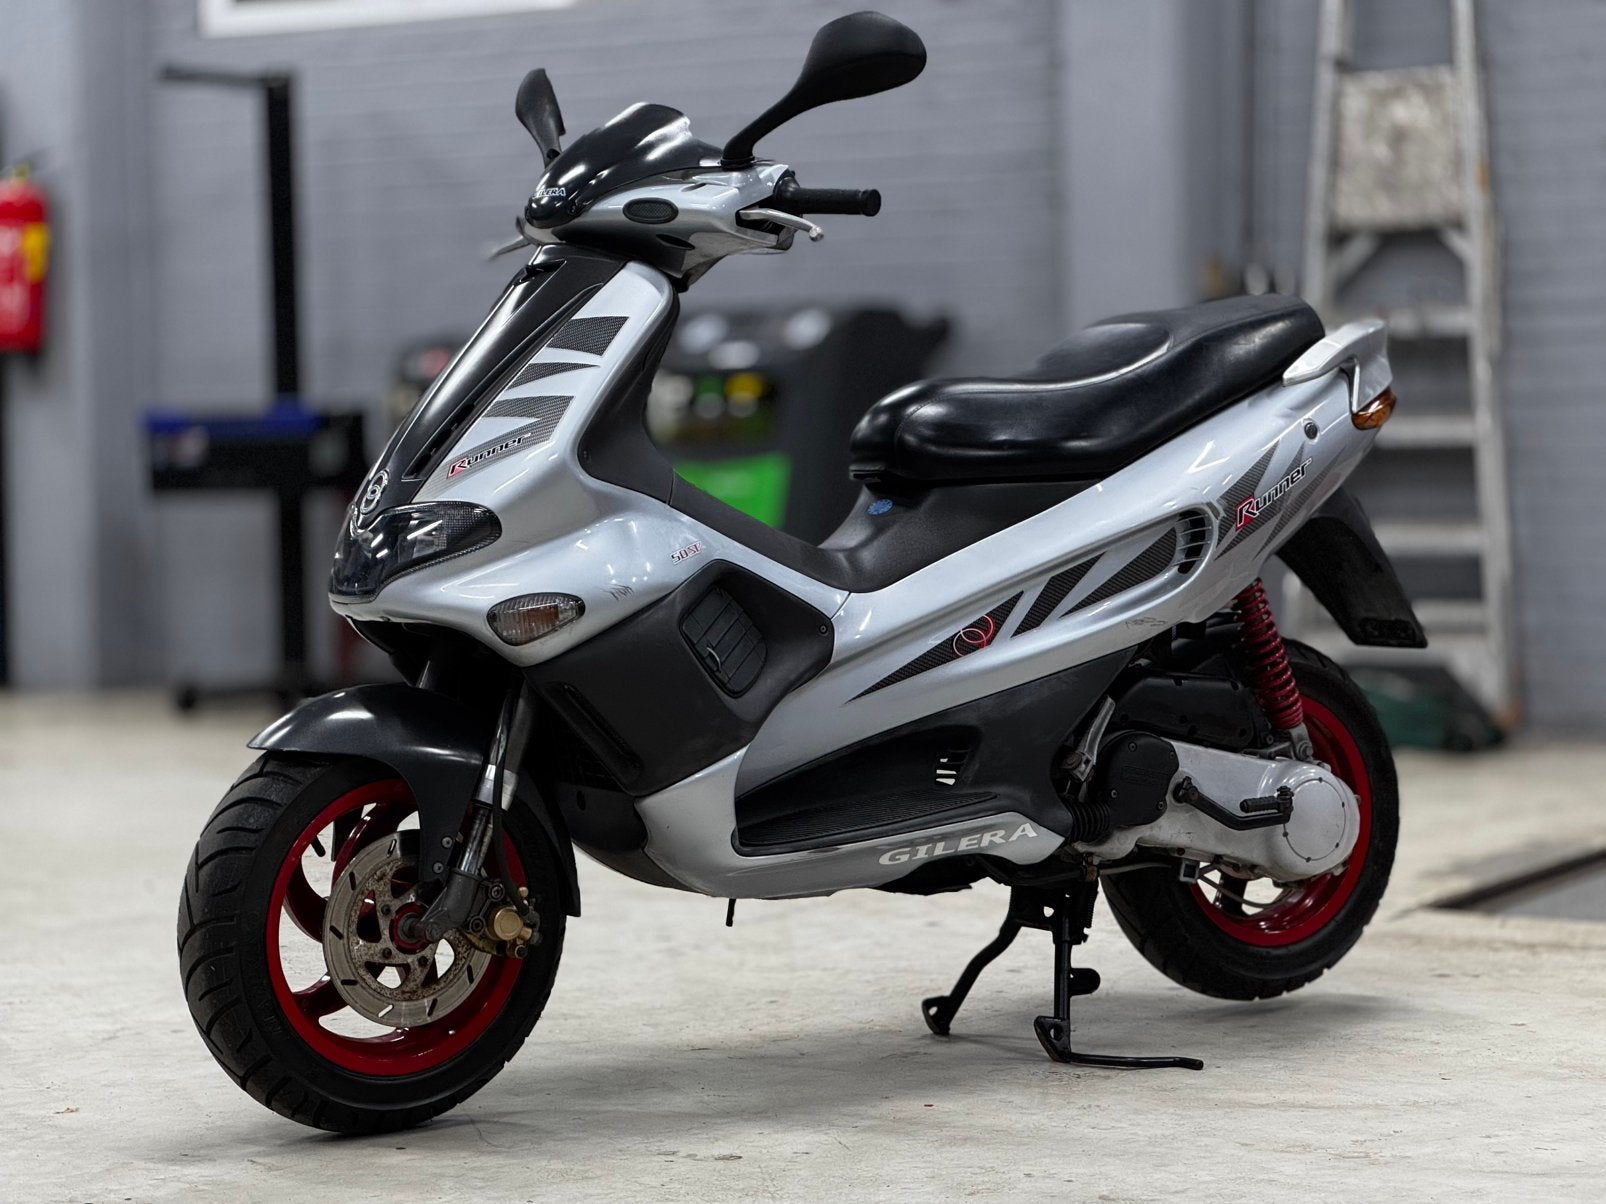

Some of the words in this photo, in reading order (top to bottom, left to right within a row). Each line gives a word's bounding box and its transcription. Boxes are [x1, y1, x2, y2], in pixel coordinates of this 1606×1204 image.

[447, 432, 531, 478] Runner
[1236, 458, 1312, 528] Runner
[878, 822, 1038, 865] GILERA
